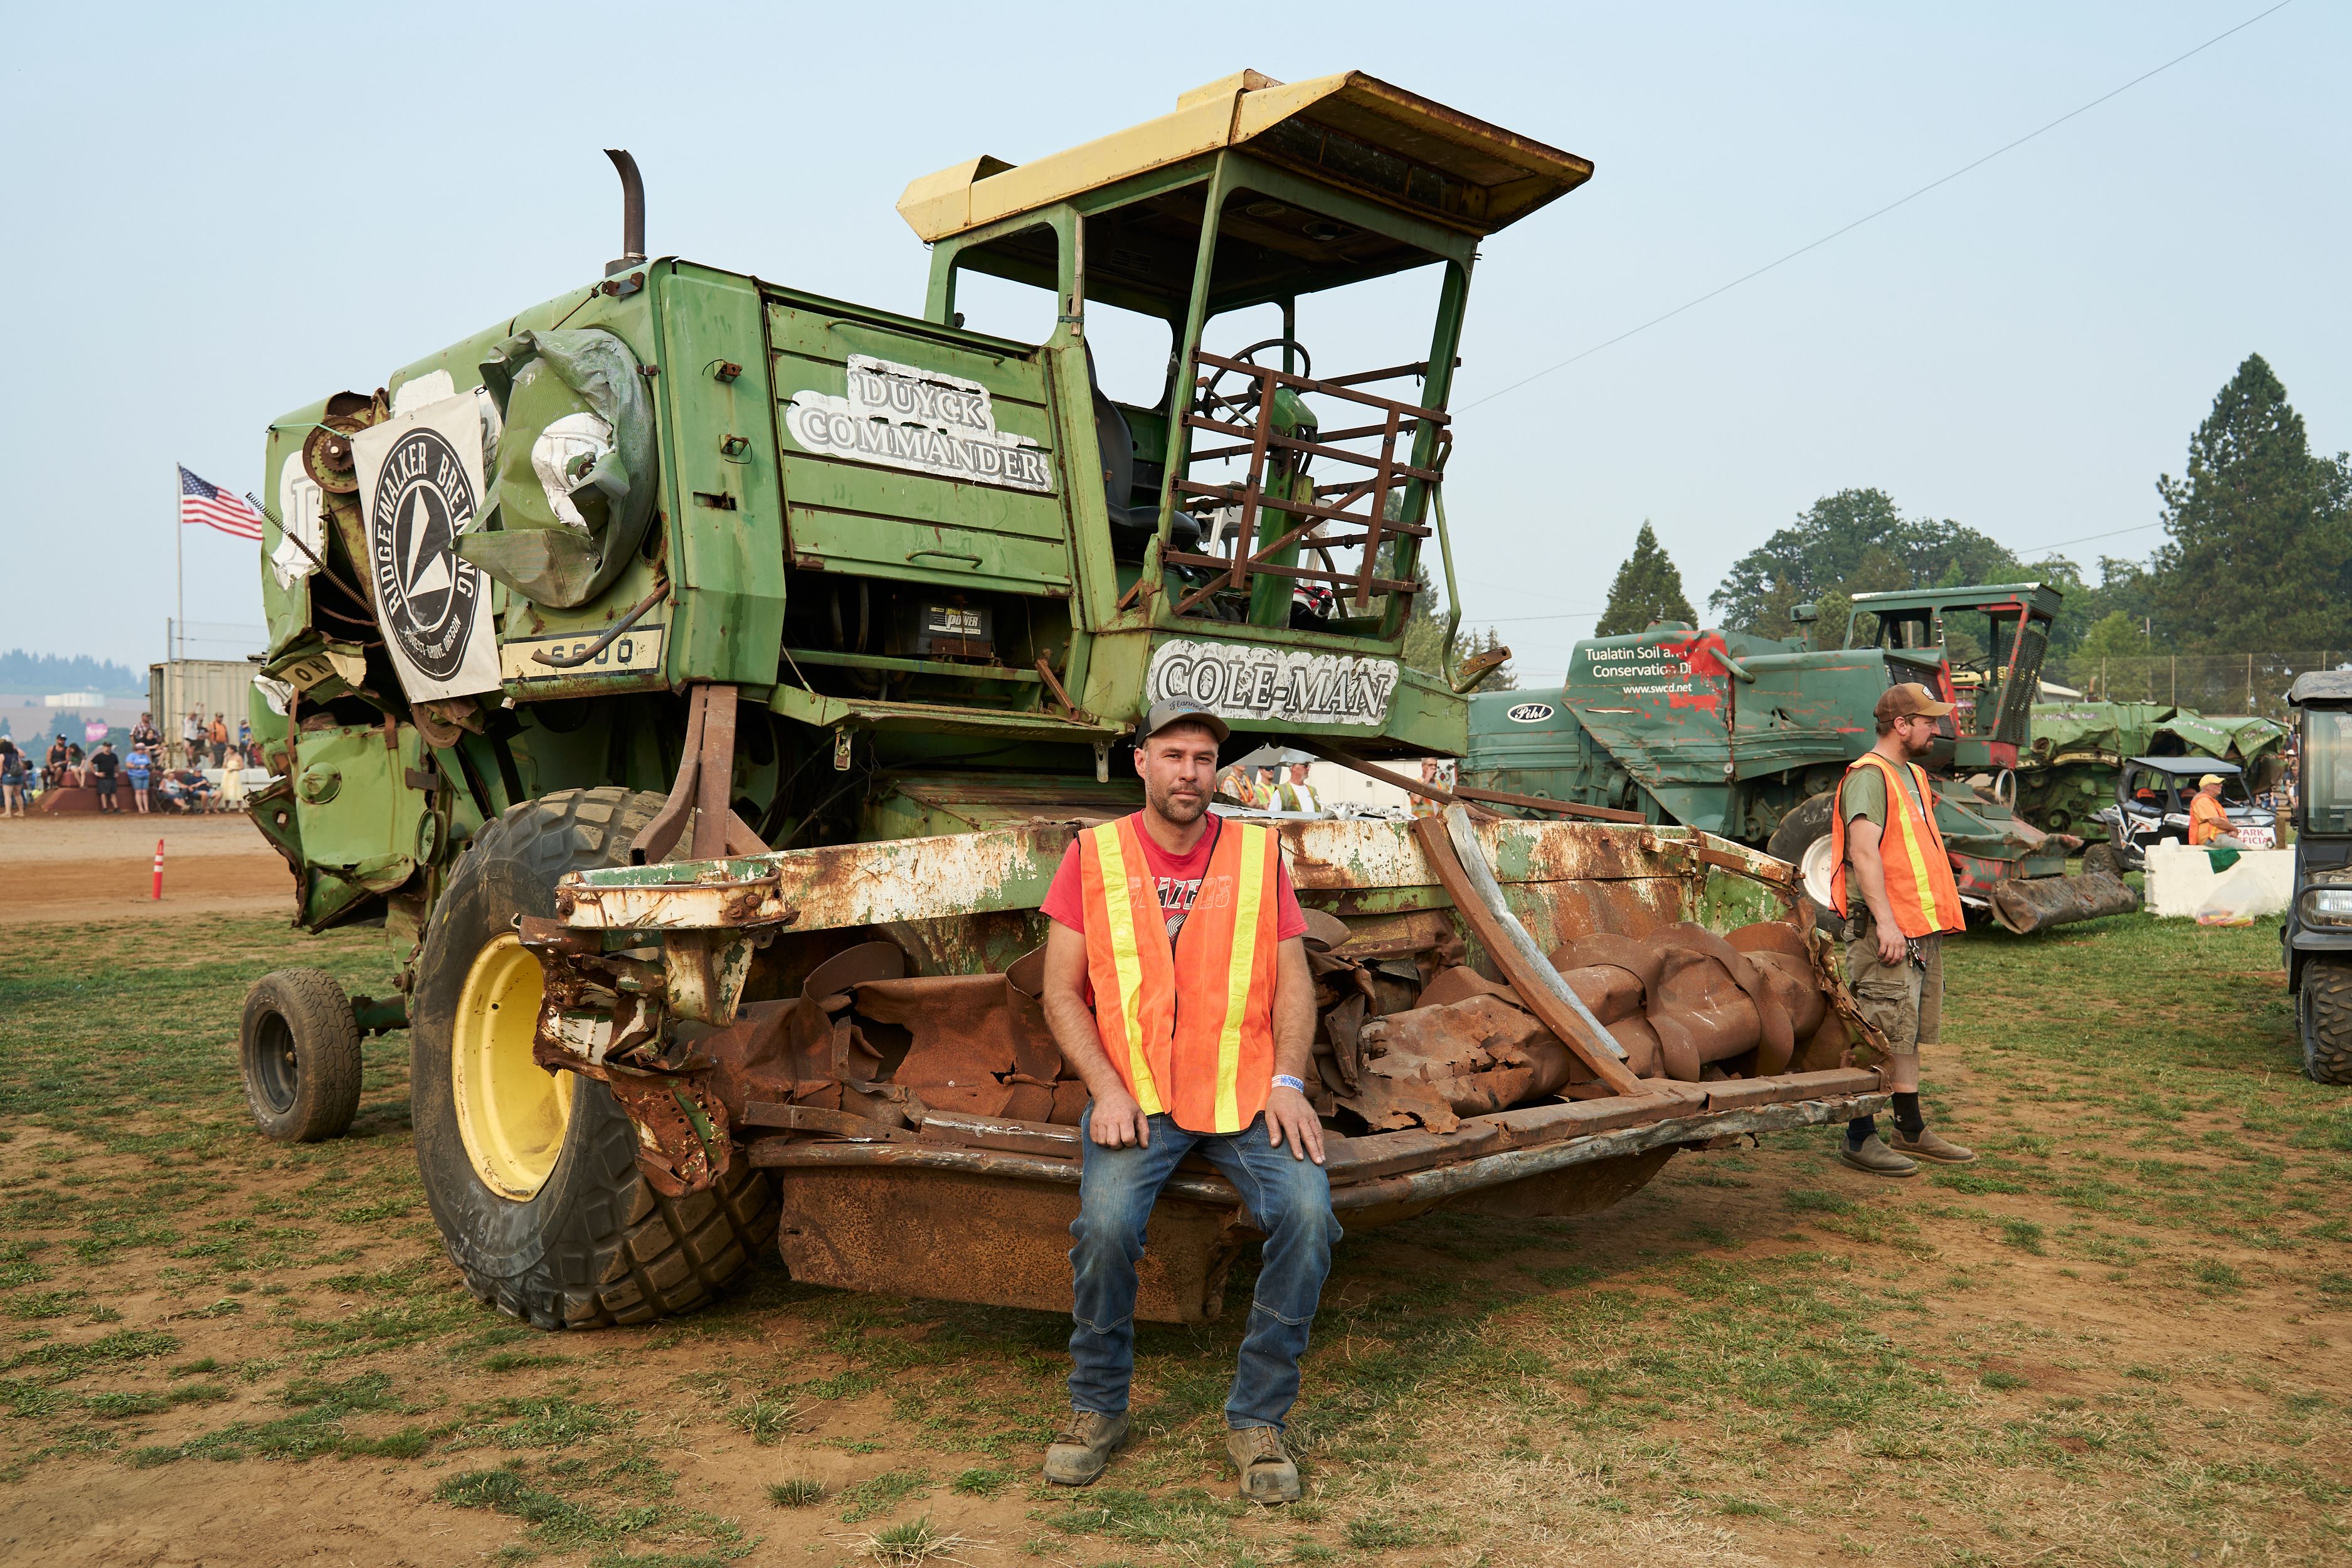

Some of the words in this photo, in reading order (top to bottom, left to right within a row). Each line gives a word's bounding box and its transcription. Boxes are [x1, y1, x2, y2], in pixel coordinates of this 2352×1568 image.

[859, 374, 986, 428] DUYCK
[800, 409, 1044, 486] COMMANDER
[437, 453, 475, 598] BREWNG
[443, 613, 461, 651] OREGON
[947, 615, 978, 630] POWER
[1585, 647, 1634, 661] Tualatin
[1637, 646, 1660, 659] Soil
[1157, 655, 1390, 718] COLE-MAN
[1623, 683, 1692, 694] www.swcd.net
[1515, 706, 1545, 719] Pihl
[1128, 876, 1232, 910] BLAZERS
